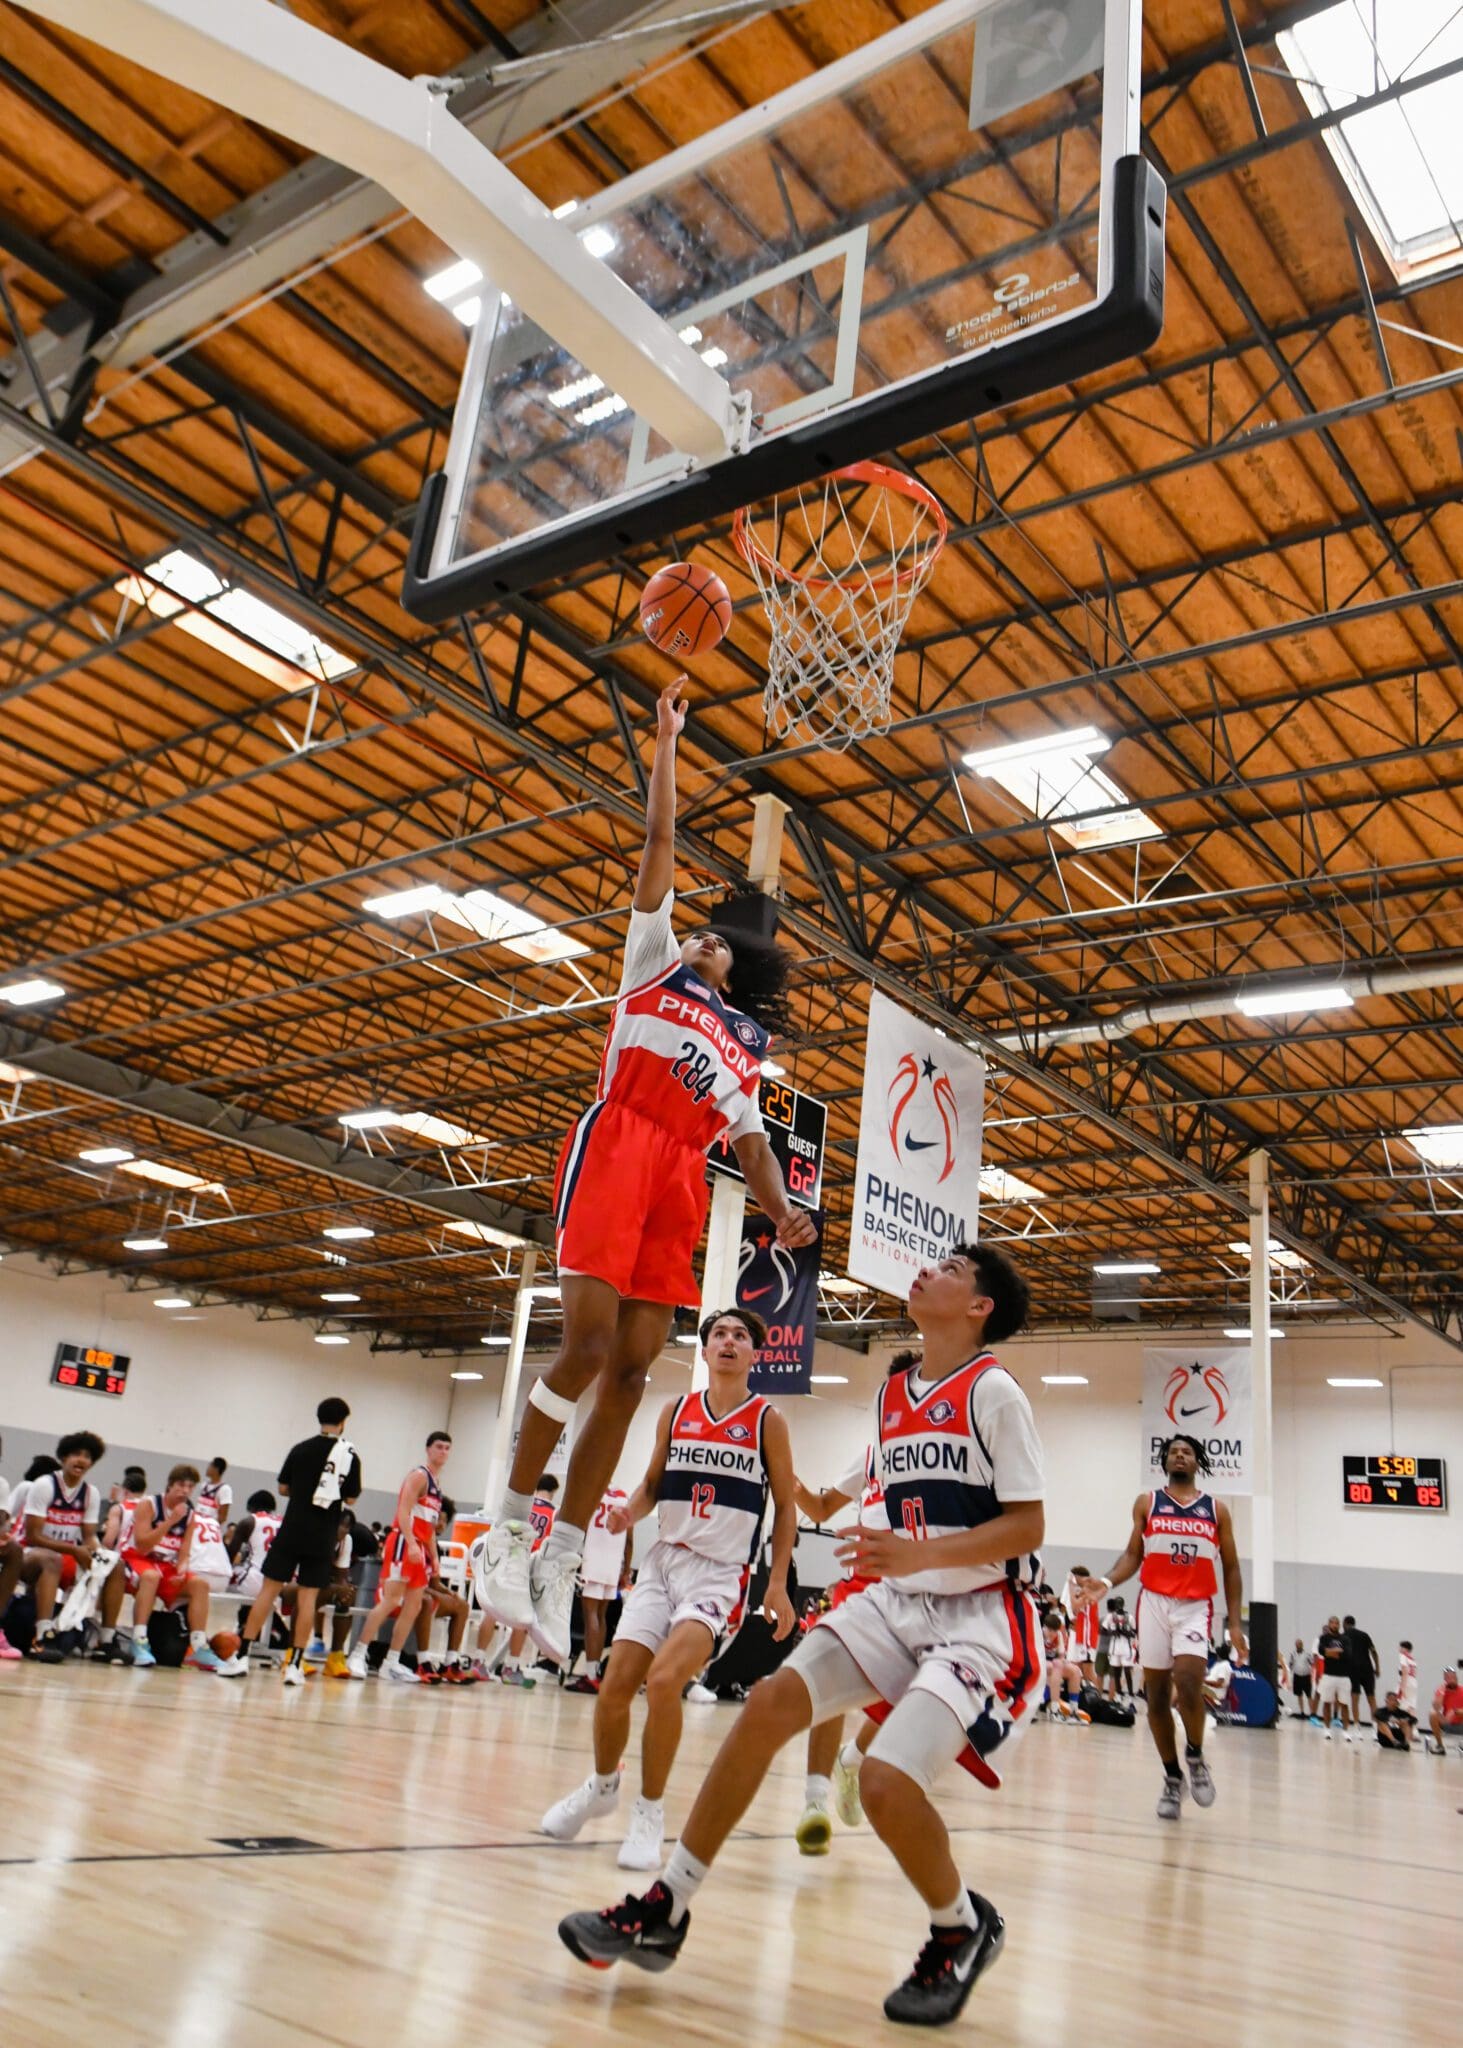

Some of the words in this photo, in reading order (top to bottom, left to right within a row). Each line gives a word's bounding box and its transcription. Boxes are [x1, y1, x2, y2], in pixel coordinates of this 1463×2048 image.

[657, 994, 761, 1079] PHENOM
[671, 1041, 718, 1104] 284
[787, 1133, 818, 1160] GUEST
[789, 1156, 817, 1198] 62
[866, 1173, 965, 1245] PHENOM
[769, 1364, 802, 1373] CAMP
[668, 1446, 756, 1475] PHENOM
[1378, 1456, 1415, 1475] 5:58
[691, 1482, 716, 1520] 12
[1349, 1483, 1373, 1504] 80
[1386, 1487, 1398, 1502] 4
[1417, 1486, 1441, 1507] 85
[1151, 1518, 1215, 1540] PHENOM
[1170, 1541, 1199, 1566] 257
